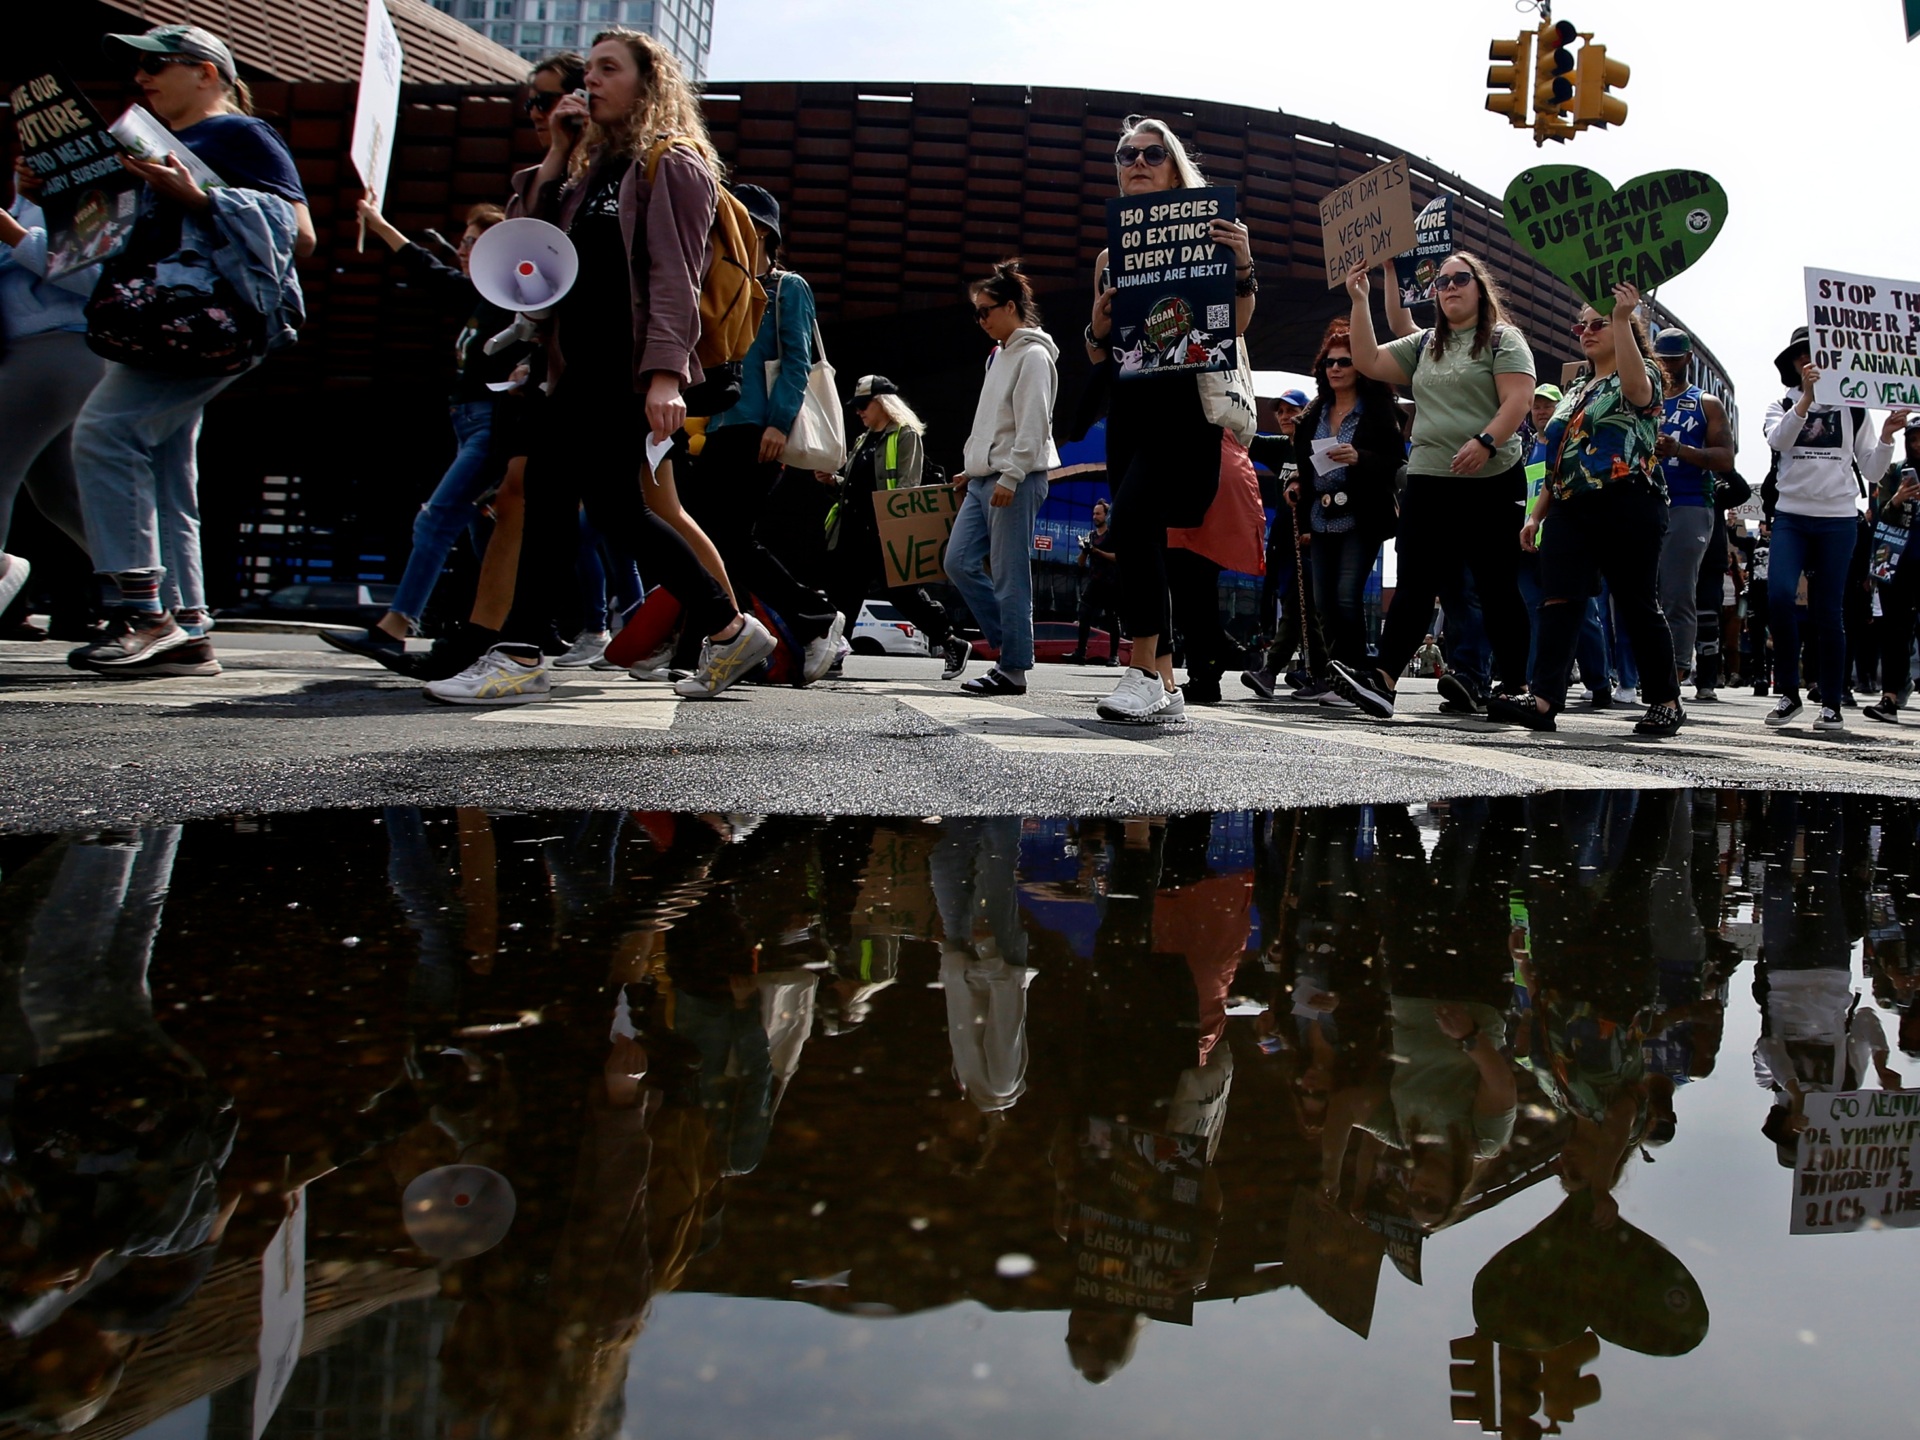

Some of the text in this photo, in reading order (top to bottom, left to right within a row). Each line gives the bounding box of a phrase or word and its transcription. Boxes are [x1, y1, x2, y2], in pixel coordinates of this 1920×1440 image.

[29, 73, 63, 102] OUR
[54, 134, 99, 165] MEAT
[97, 130, 116, 148] &
[1321, 164, 1404, 227] EVERY DAY IS
[1429, 197, 1447, 211] OUR
[1509, 168, 1593, 225] LOVE
[1120, 200, 1219, 227] 150 SPECIES
[1414, 210, 1447, 231] TURE
[1527, 170, 1711, 250] SUSTAINABLY
[1121, 230, 1141, 249] GO
[1338, 206, 1382, 247] VEGAN
[1416, 229, 1450, 243] MEAT &
[1583, 211, 1665, 261] LIVE
[1124, 244, 1216, 271] EVERY DAY
[1329, 226, 1393, 282] EARTH DAY
[1117, 263, 1228, 289] HUMANS ARE NEXT!
[1570, 239, 1687, 303] VEGAN
[1819, 279, 1920, 313] STOP TH
[1145, 308, 1175, 327] VEGAN
[1148, 318, 1177, 334] EARTH
[1814, 305, 1900, 333] MURDER
[1161, 327, 1178, 338] MARCH
[1815, 328, 1918, 355] TORTURE
[1138, 361, 1210, 374] veganearthdaymarch.org
[1815, 350, 1843, 370] OF
[1840, 376, 1920, 405] GO VEGA
[1661, 407, 1699, 432] GAN
[887, 488, 957, 518] GRET
